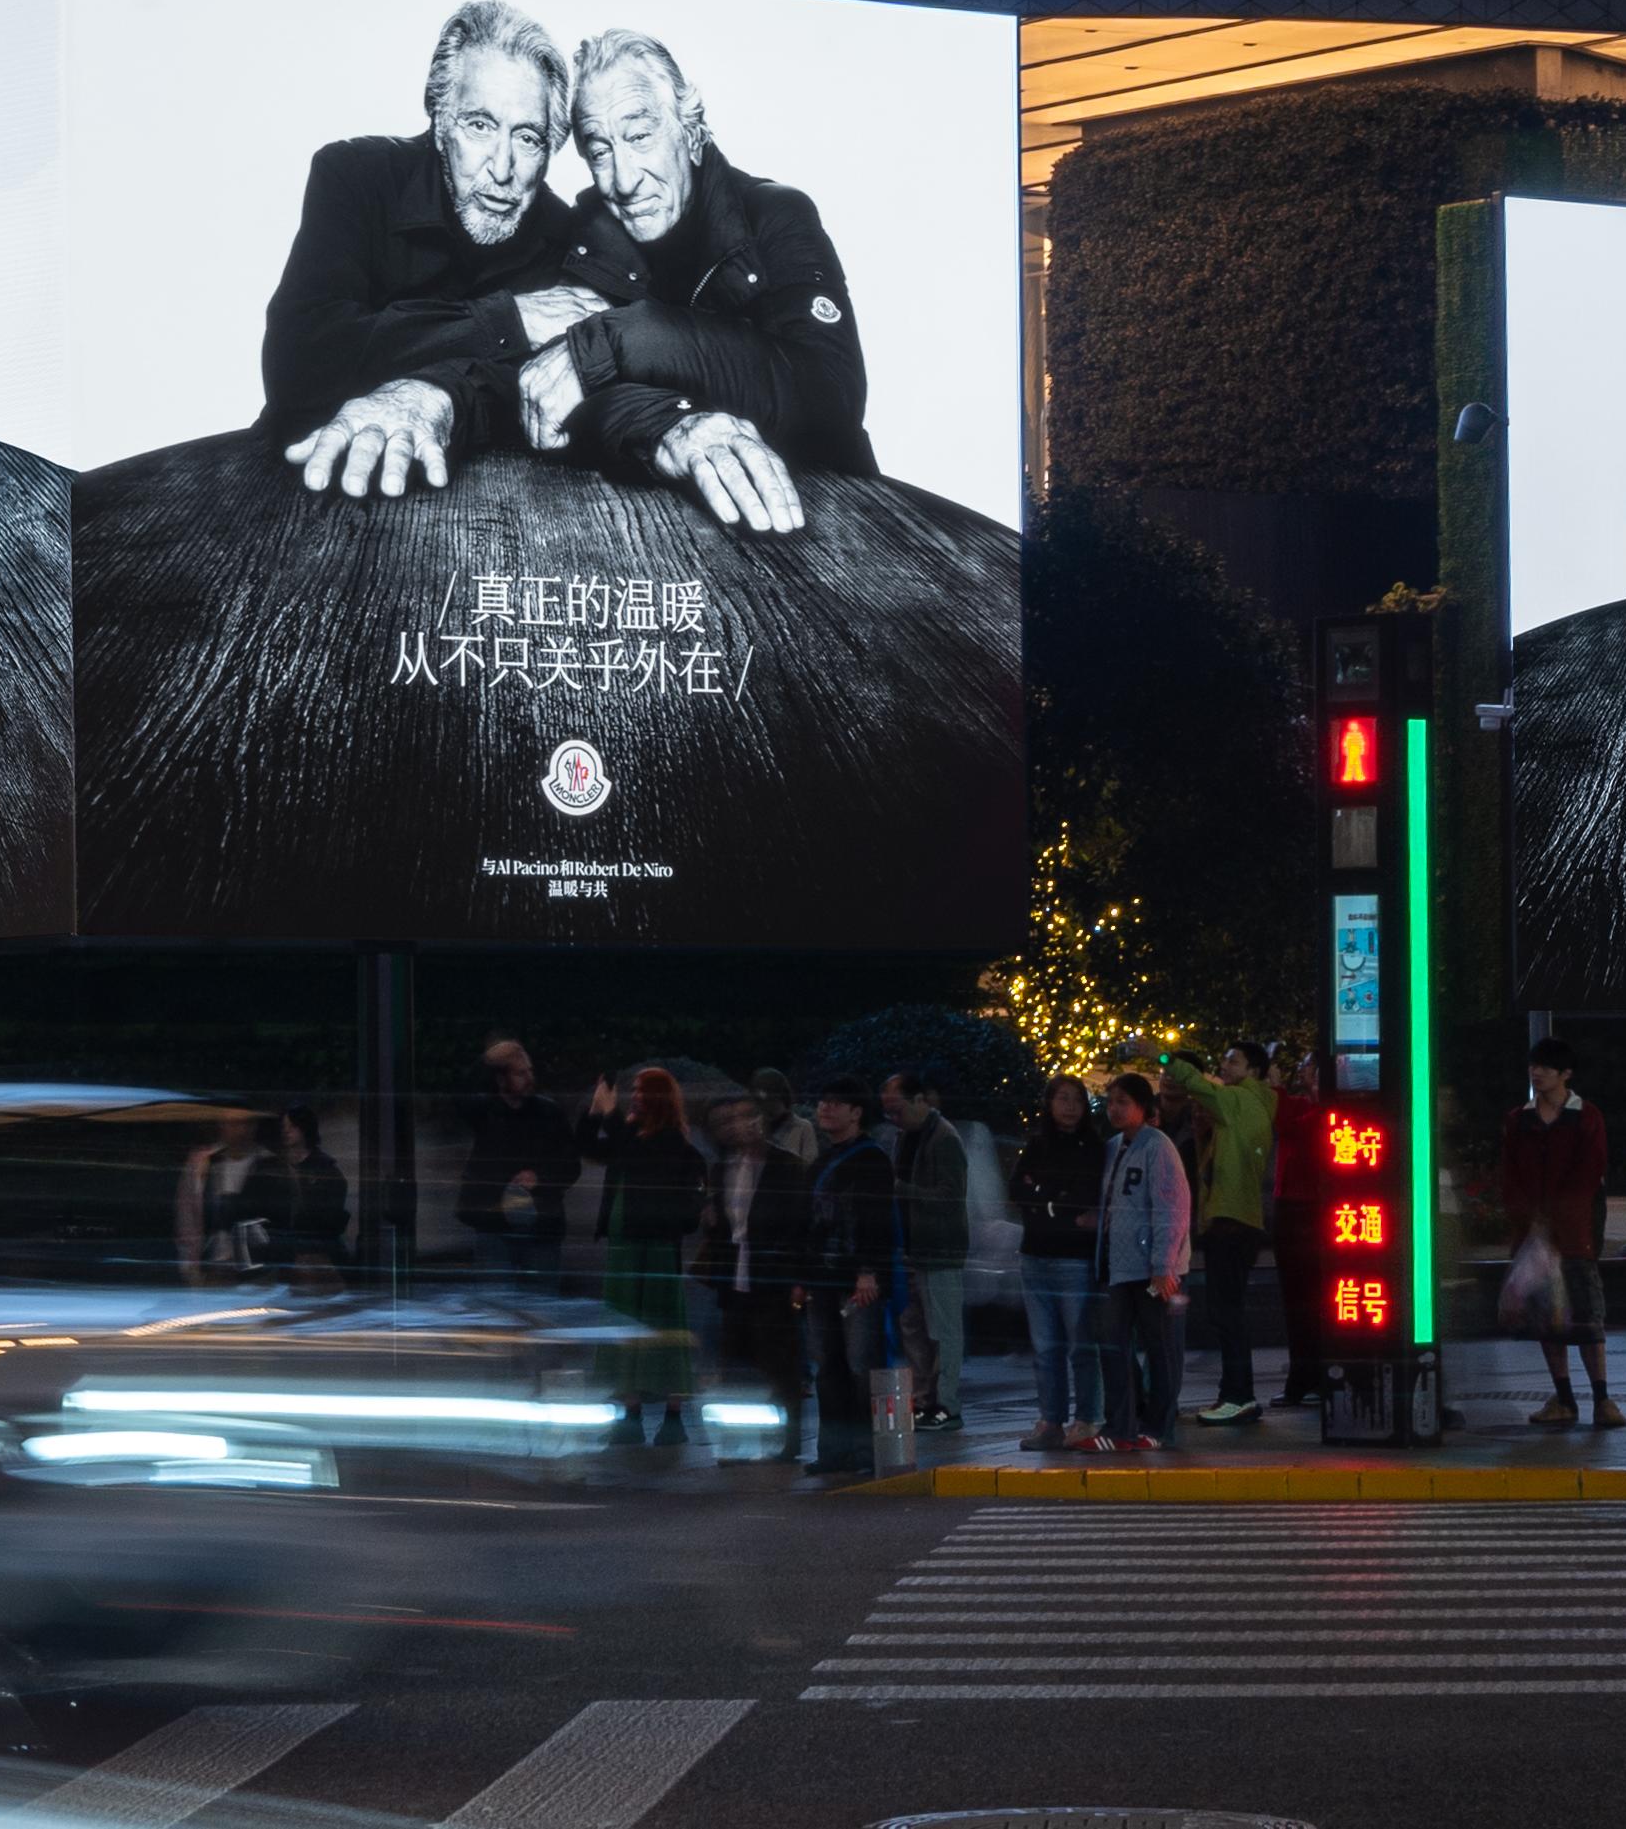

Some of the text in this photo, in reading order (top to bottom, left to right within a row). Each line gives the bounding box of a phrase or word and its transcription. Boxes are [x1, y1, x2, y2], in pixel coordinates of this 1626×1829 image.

[470, 570, 707, 634] 真正的温暖
[389, 631, 725, 695] 从不只关乎外在
[552, 781, 602, 805] MONCLER
[548, 880, 608, 898] 温暖与共
[1122, 1165, 1143, 1197] P
[1333, 1201, 1385, 1248] 交通
[1333, 1275, 1389, 1327] 信号
